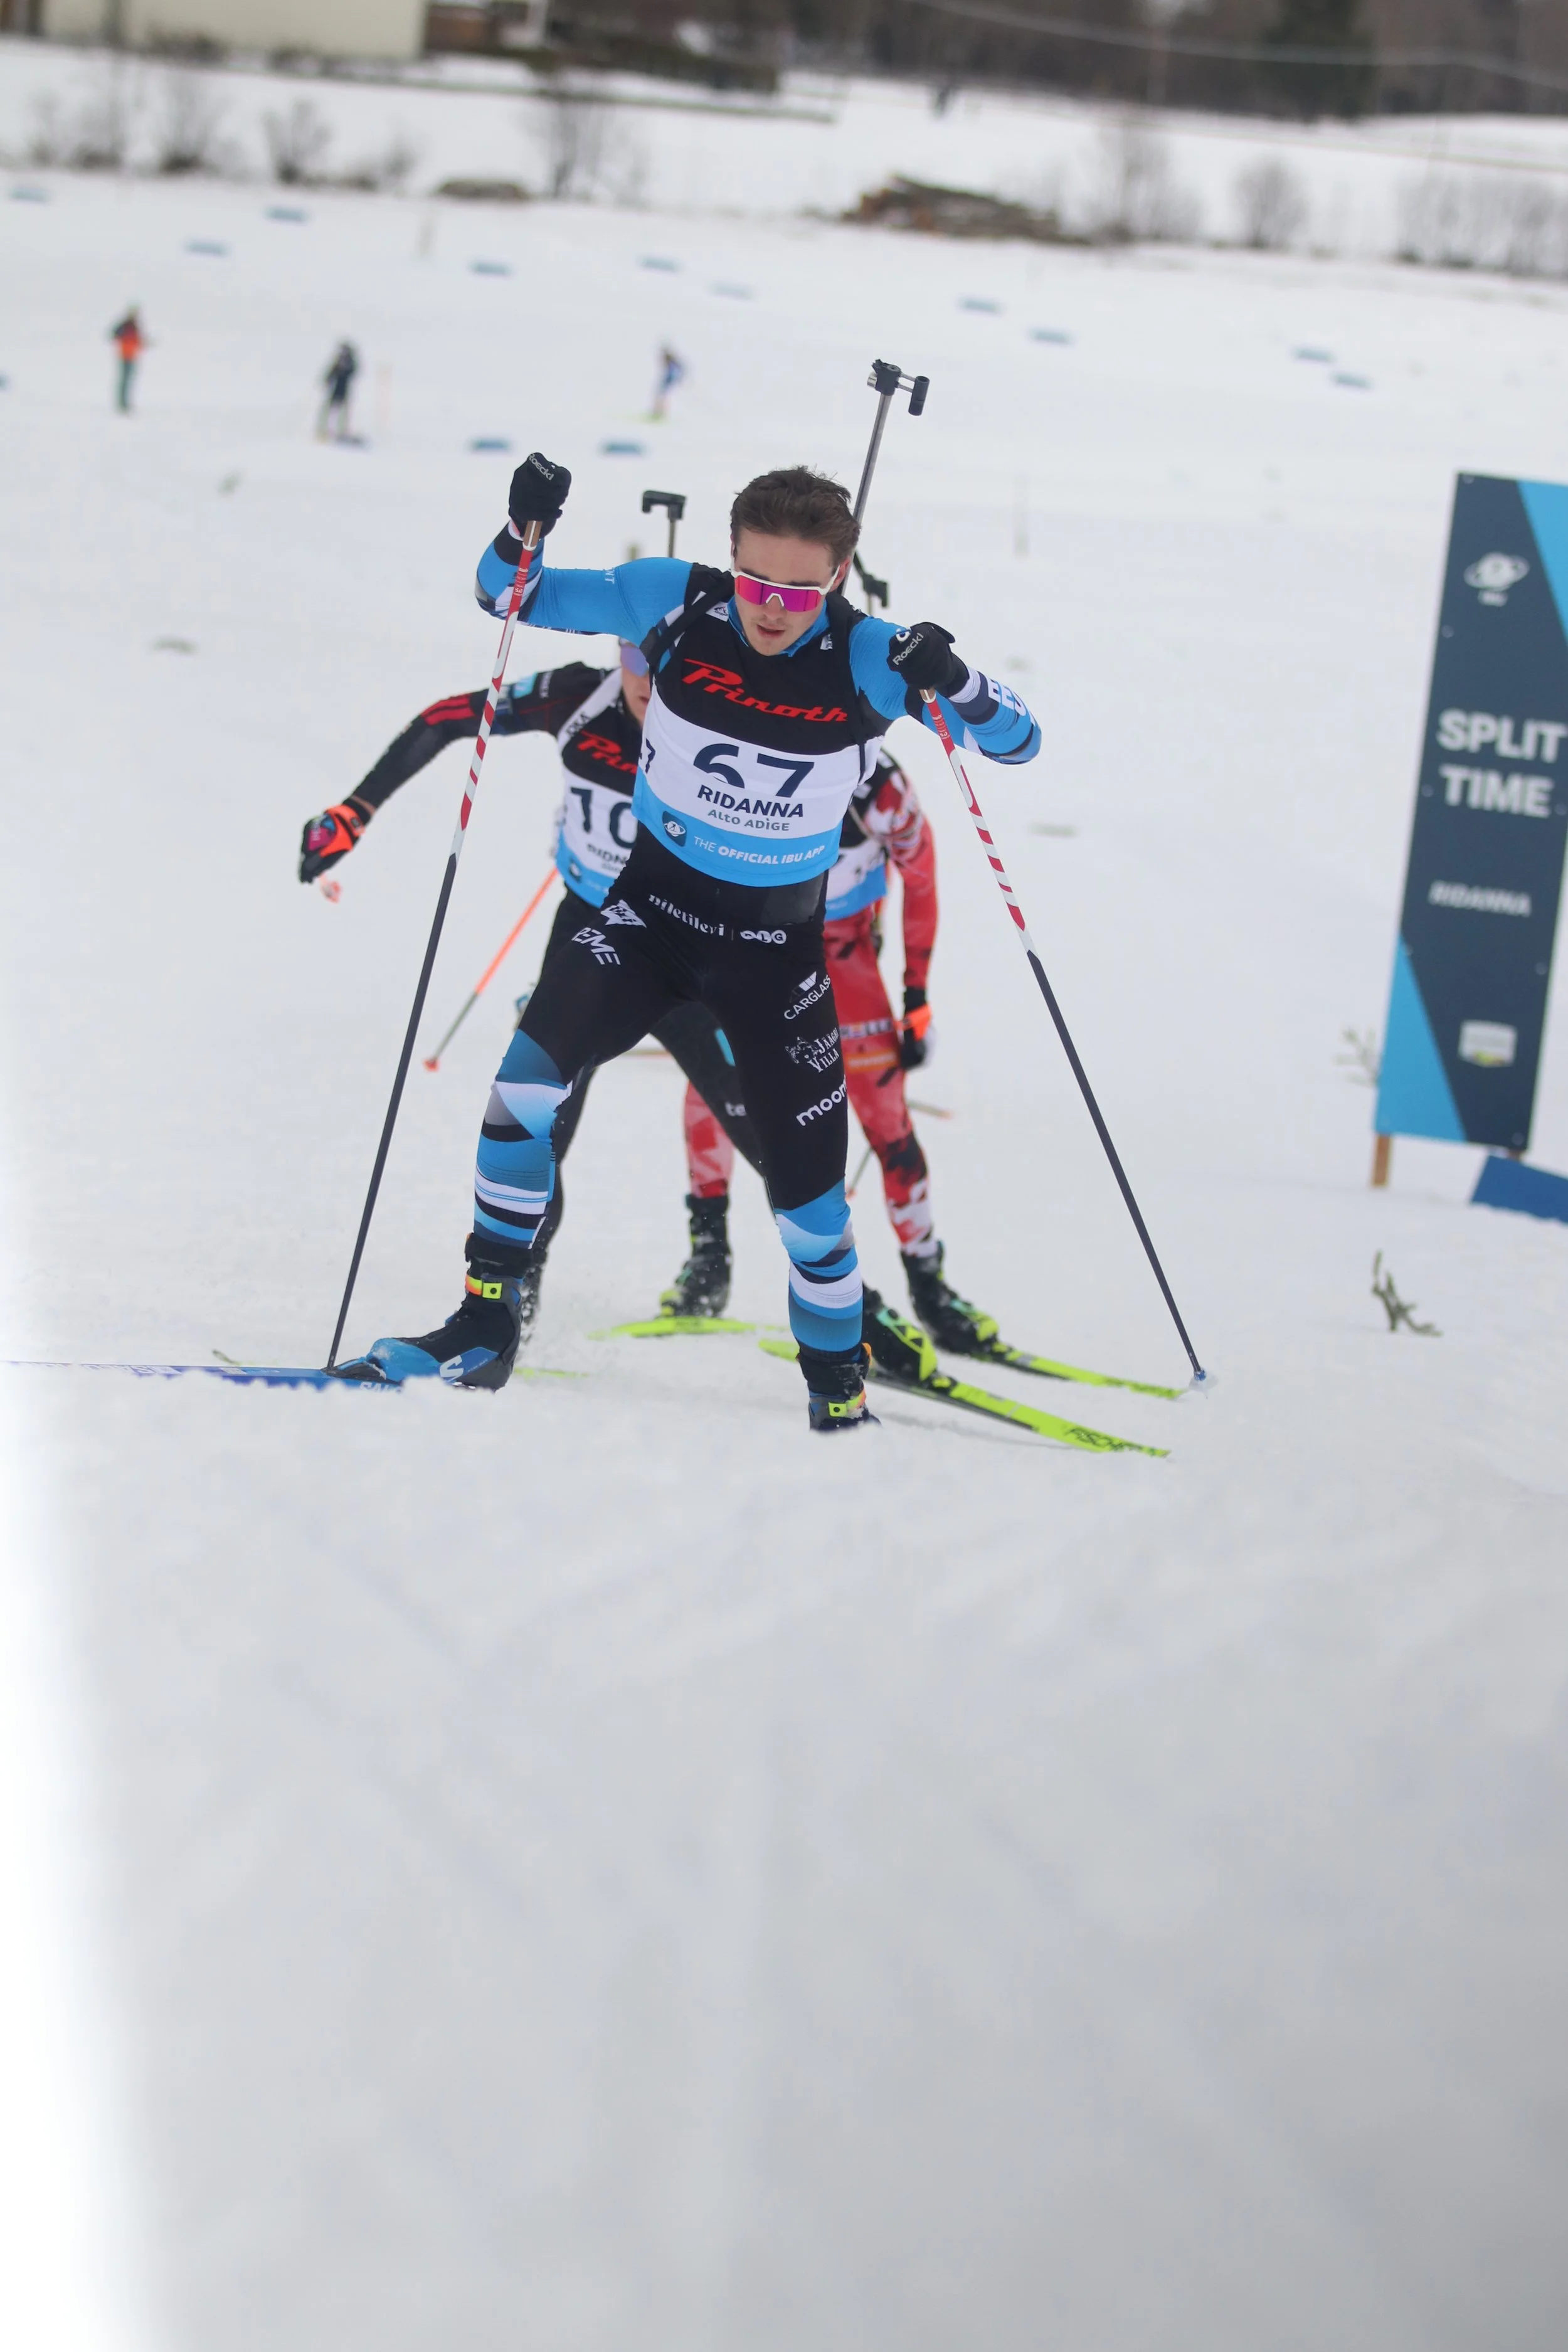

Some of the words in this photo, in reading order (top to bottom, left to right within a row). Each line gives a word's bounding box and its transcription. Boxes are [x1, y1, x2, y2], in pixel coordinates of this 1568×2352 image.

[893, 632, 924, 666] Roeckl
[682, 658, 848, 723] Prinoth
[1436, 708, 1568, 763] SPLIT
[693, 743, 815, 798] 67
[1439, 763, 1554, 818] TIME
[697, 785, 804, 818] RIDANNA
[694, 836, 717, 852] THE
[718, 845, 778, 865] OFFICIAL
[781, 853, 803, 864] IBU
[804, 845, 825, 861] APP
[783, 975, 831, 1020] CARGLASS
